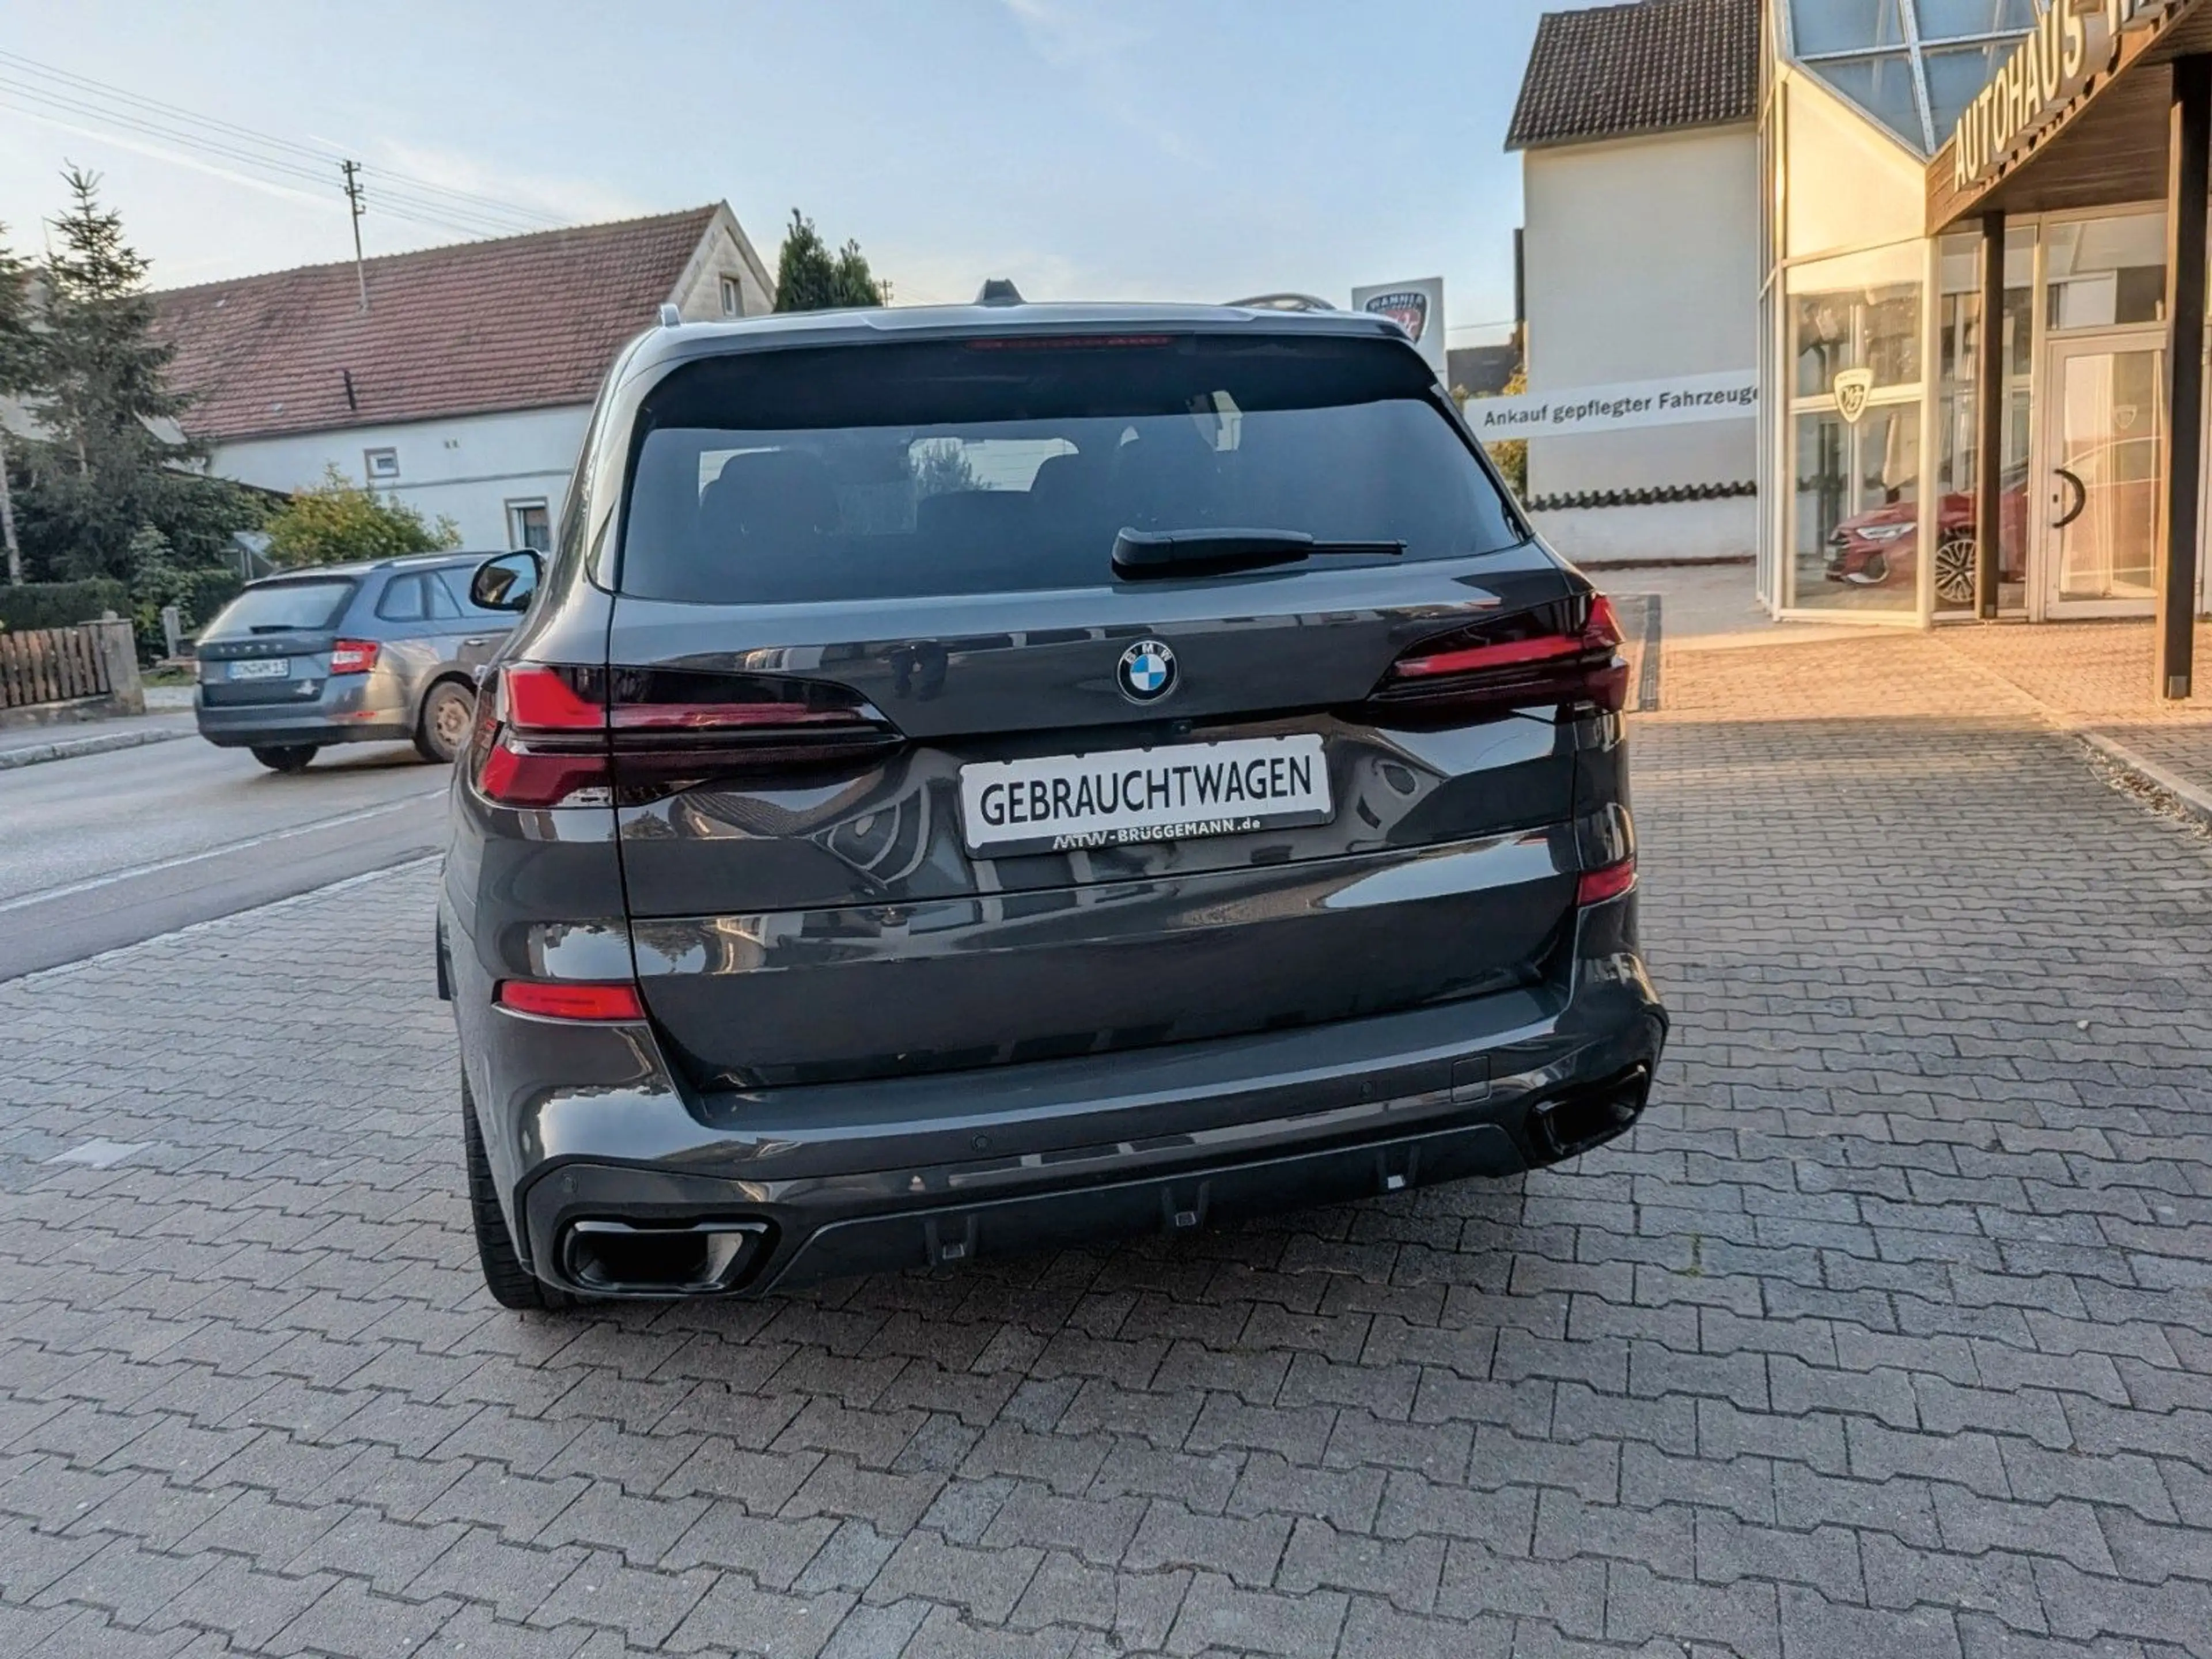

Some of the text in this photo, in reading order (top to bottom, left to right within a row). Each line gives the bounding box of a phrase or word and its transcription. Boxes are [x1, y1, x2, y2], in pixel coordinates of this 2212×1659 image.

[1954, 0, 2085, 192] AUTOHAUS
[1484, 404, 1550, 427] Ankauf
[1552, 396, 1652, 425] gepflegter
[1124, 643, 1173, 664] BMW
[980, 755, 1313, 826] GEBRAUCHTWAGEN
